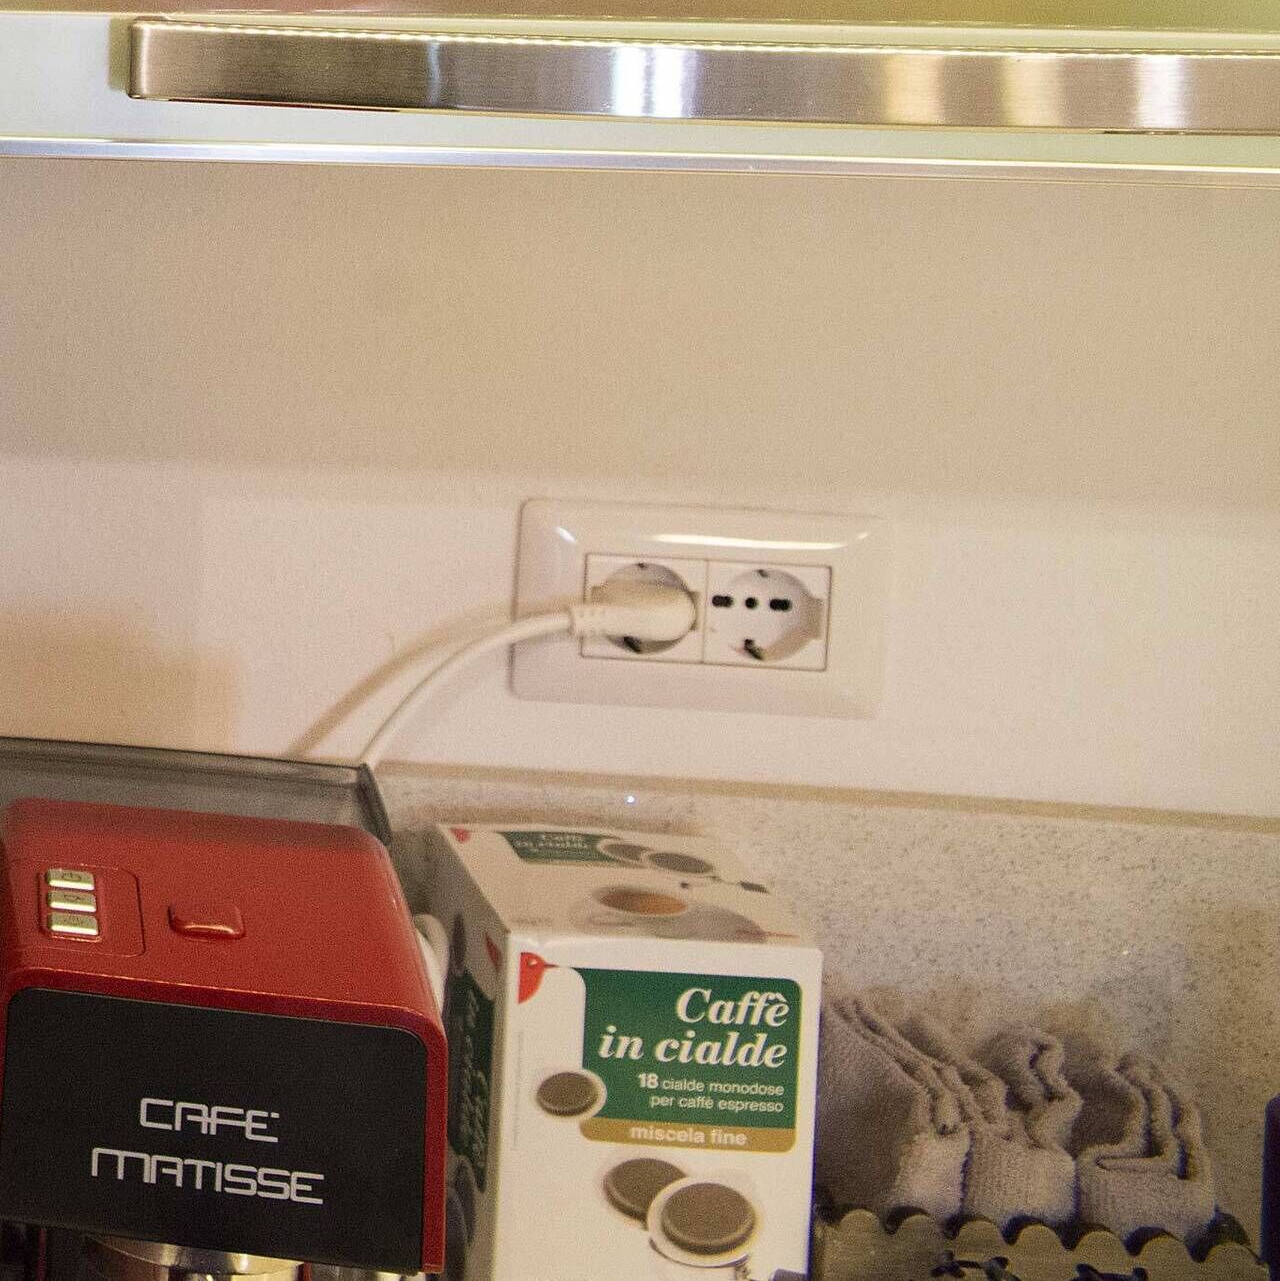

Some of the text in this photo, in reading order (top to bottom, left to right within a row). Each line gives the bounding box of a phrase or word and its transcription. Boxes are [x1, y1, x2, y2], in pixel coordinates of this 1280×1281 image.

[675, 987, 789, 1027] Caffè
[598, 1025, 788, 1068] in cialde
[639, 1073, 785, 1096] 18 cialde monodose
[650, 1095, 784, 1113] per caffè espresso
[630, 1125, 748, 1146] miscela fine
[91, 1148, 325, 1205] MATISSE
